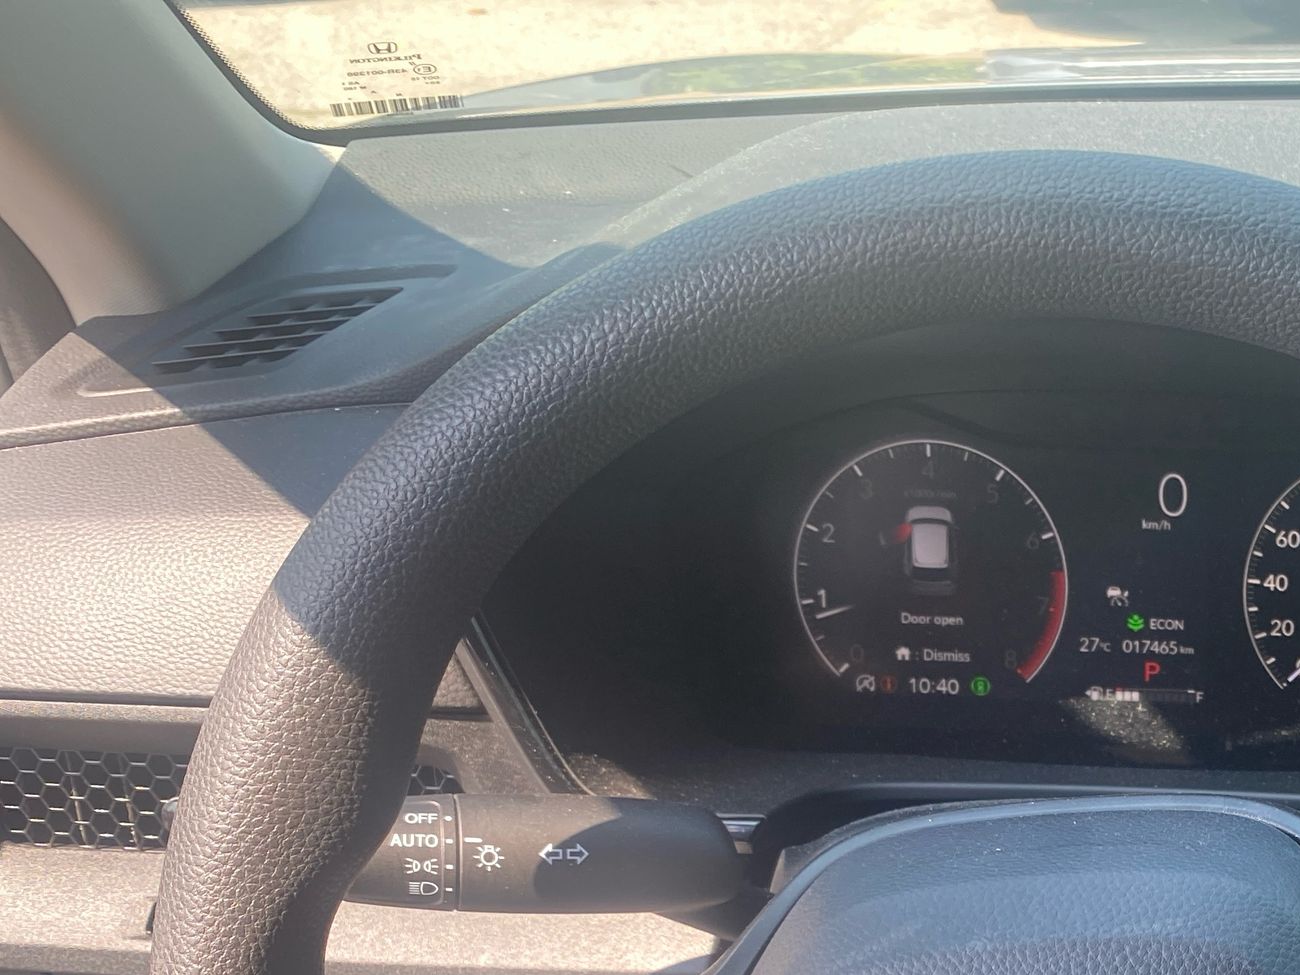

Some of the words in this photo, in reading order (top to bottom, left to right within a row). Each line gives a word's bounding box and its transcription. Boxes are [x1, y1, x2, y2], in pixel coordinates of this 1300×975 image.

[1159, 473, 1187, 517] 0
[822, 523, 835, 543] 2
[1141, 519, 1171, 532] km/h
[1275, 531, 1300, 549] 60
[1263, 574, 1289, 592] 40
[817, 589, 826, 608] 1
[901, 611, 930, 624] Door
[934, 616, 964, 627] open
[1150, 618, 1184, 631] ECON
[1270, 619, 1294, 637] 20
[923, 648, 970, 662] Dismiss
[1122, 640, 1178, 655] 017465
[1144, 661, 1162, 682] P
[909, 678, 960, 695] 10:40
[404, 812, 438, 825] OFF
[390, 833, 439, 848] AUTO
